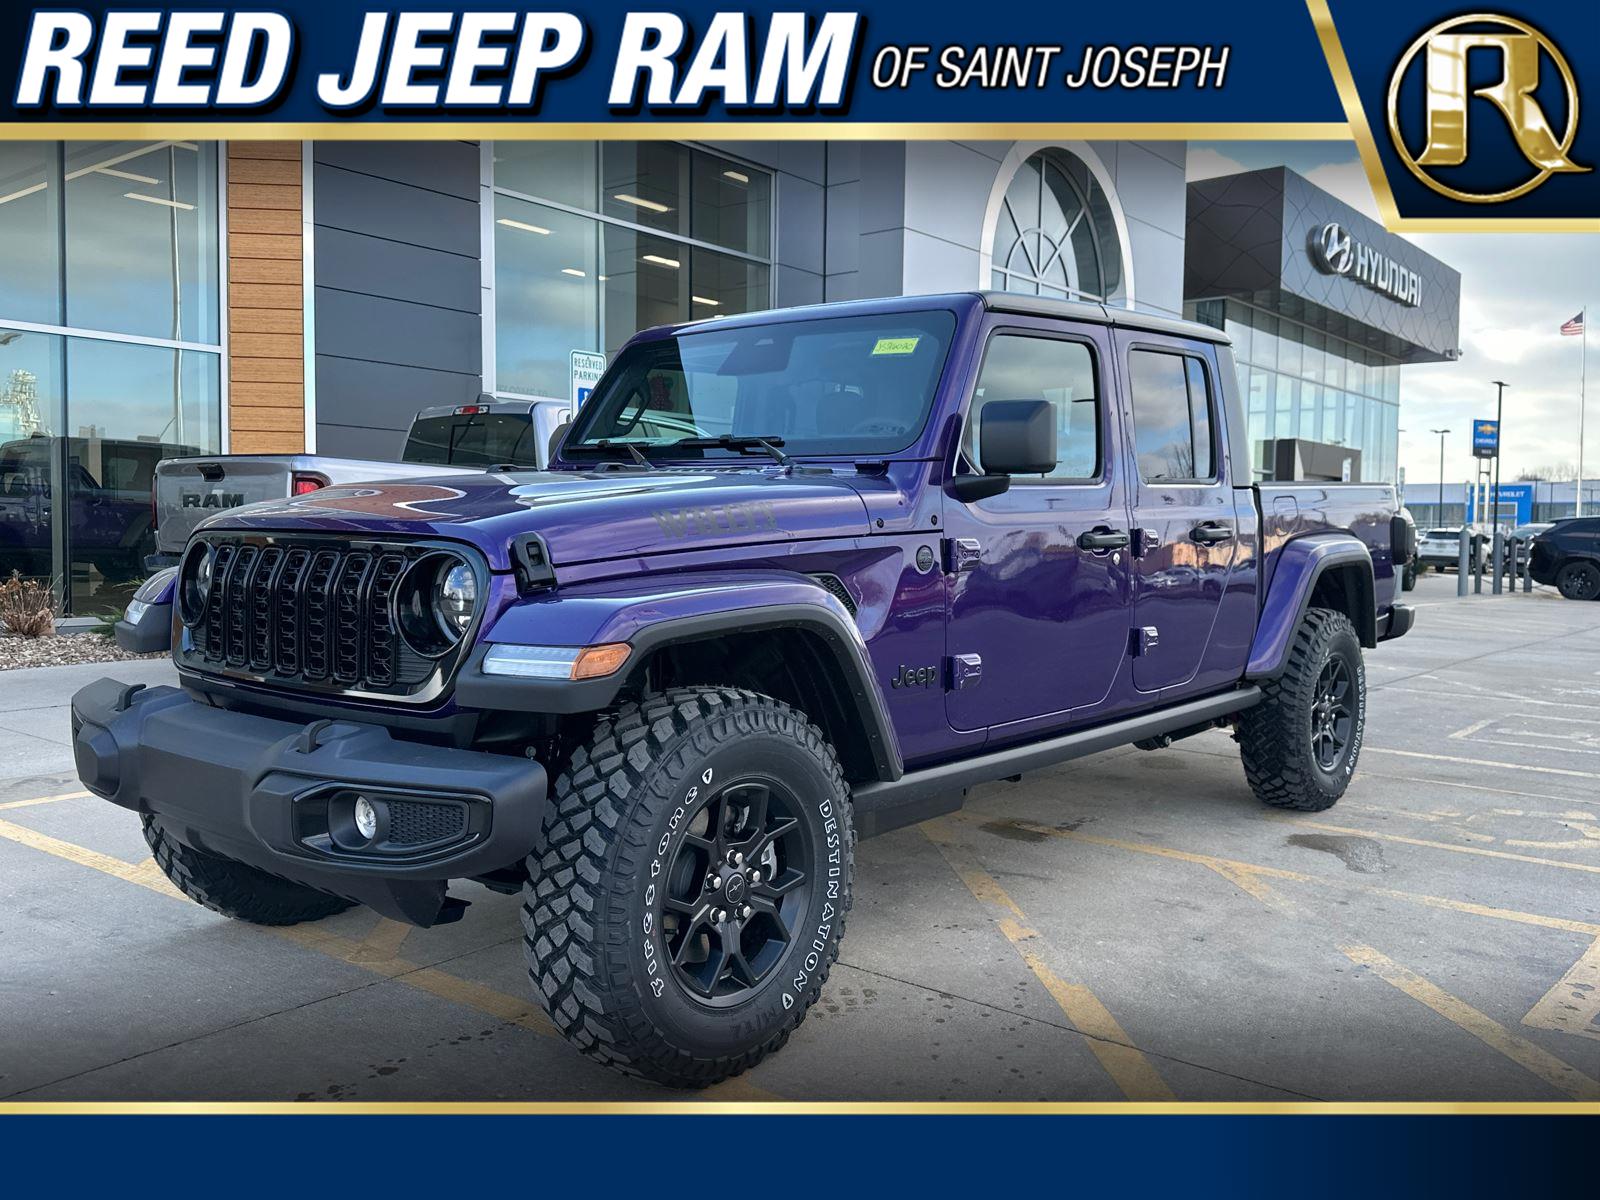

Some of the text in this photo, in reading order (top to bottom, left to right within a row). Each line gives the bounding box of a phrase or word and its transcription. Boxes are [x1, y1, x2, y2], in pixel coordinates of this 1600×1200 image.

[1356, 242, 1422, 307] HYUNDAI
[573, 356, 603, 371] RESERVED
[182, 493, 244, 508] RAM
[891, 665, 936, 689] Jeep
[793, 799, 840, 993] DESTINATION
